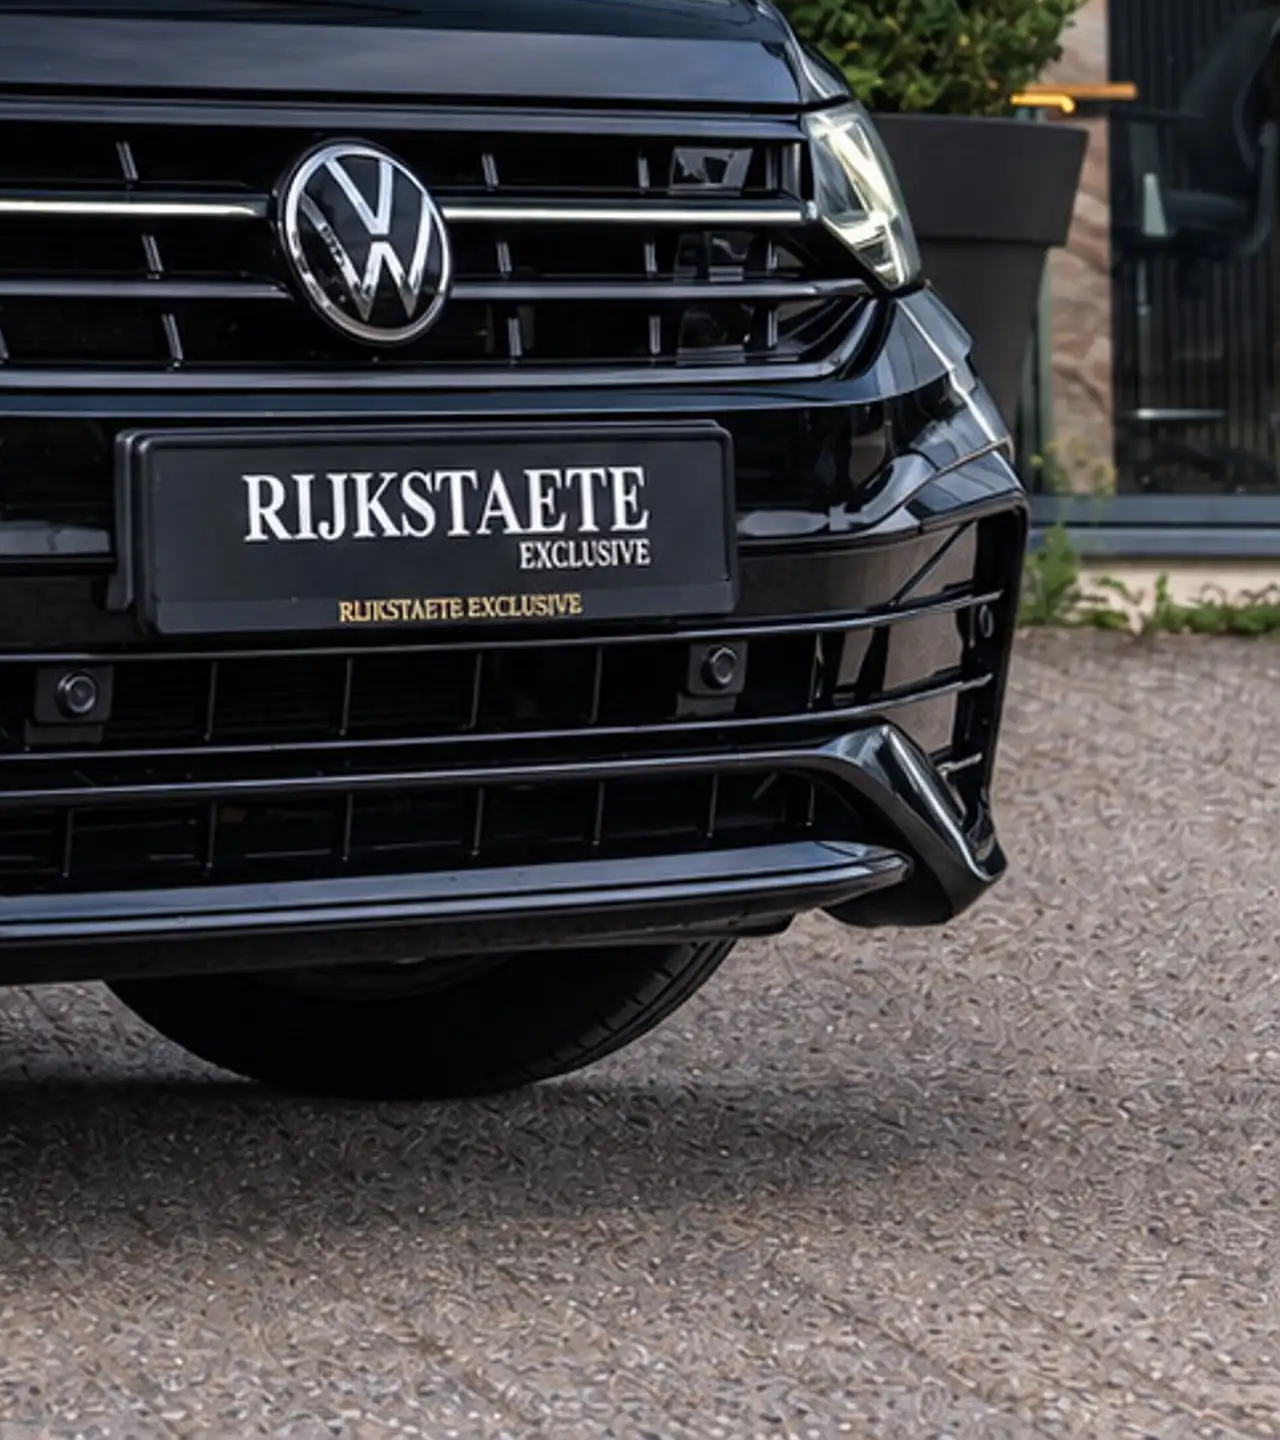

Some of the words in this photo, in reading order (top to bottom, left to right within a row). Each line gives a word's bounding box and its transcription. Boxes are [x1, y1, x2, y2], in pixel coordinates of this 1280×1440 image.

[242, 466, 650, 542] RIJKSTAETE
[519, 538, 651, 569] EXCLUSIVE
[338, 596, 464, 623] RIJKSTAETE
[467, 592, 583, 619] EXCLUSIVE
